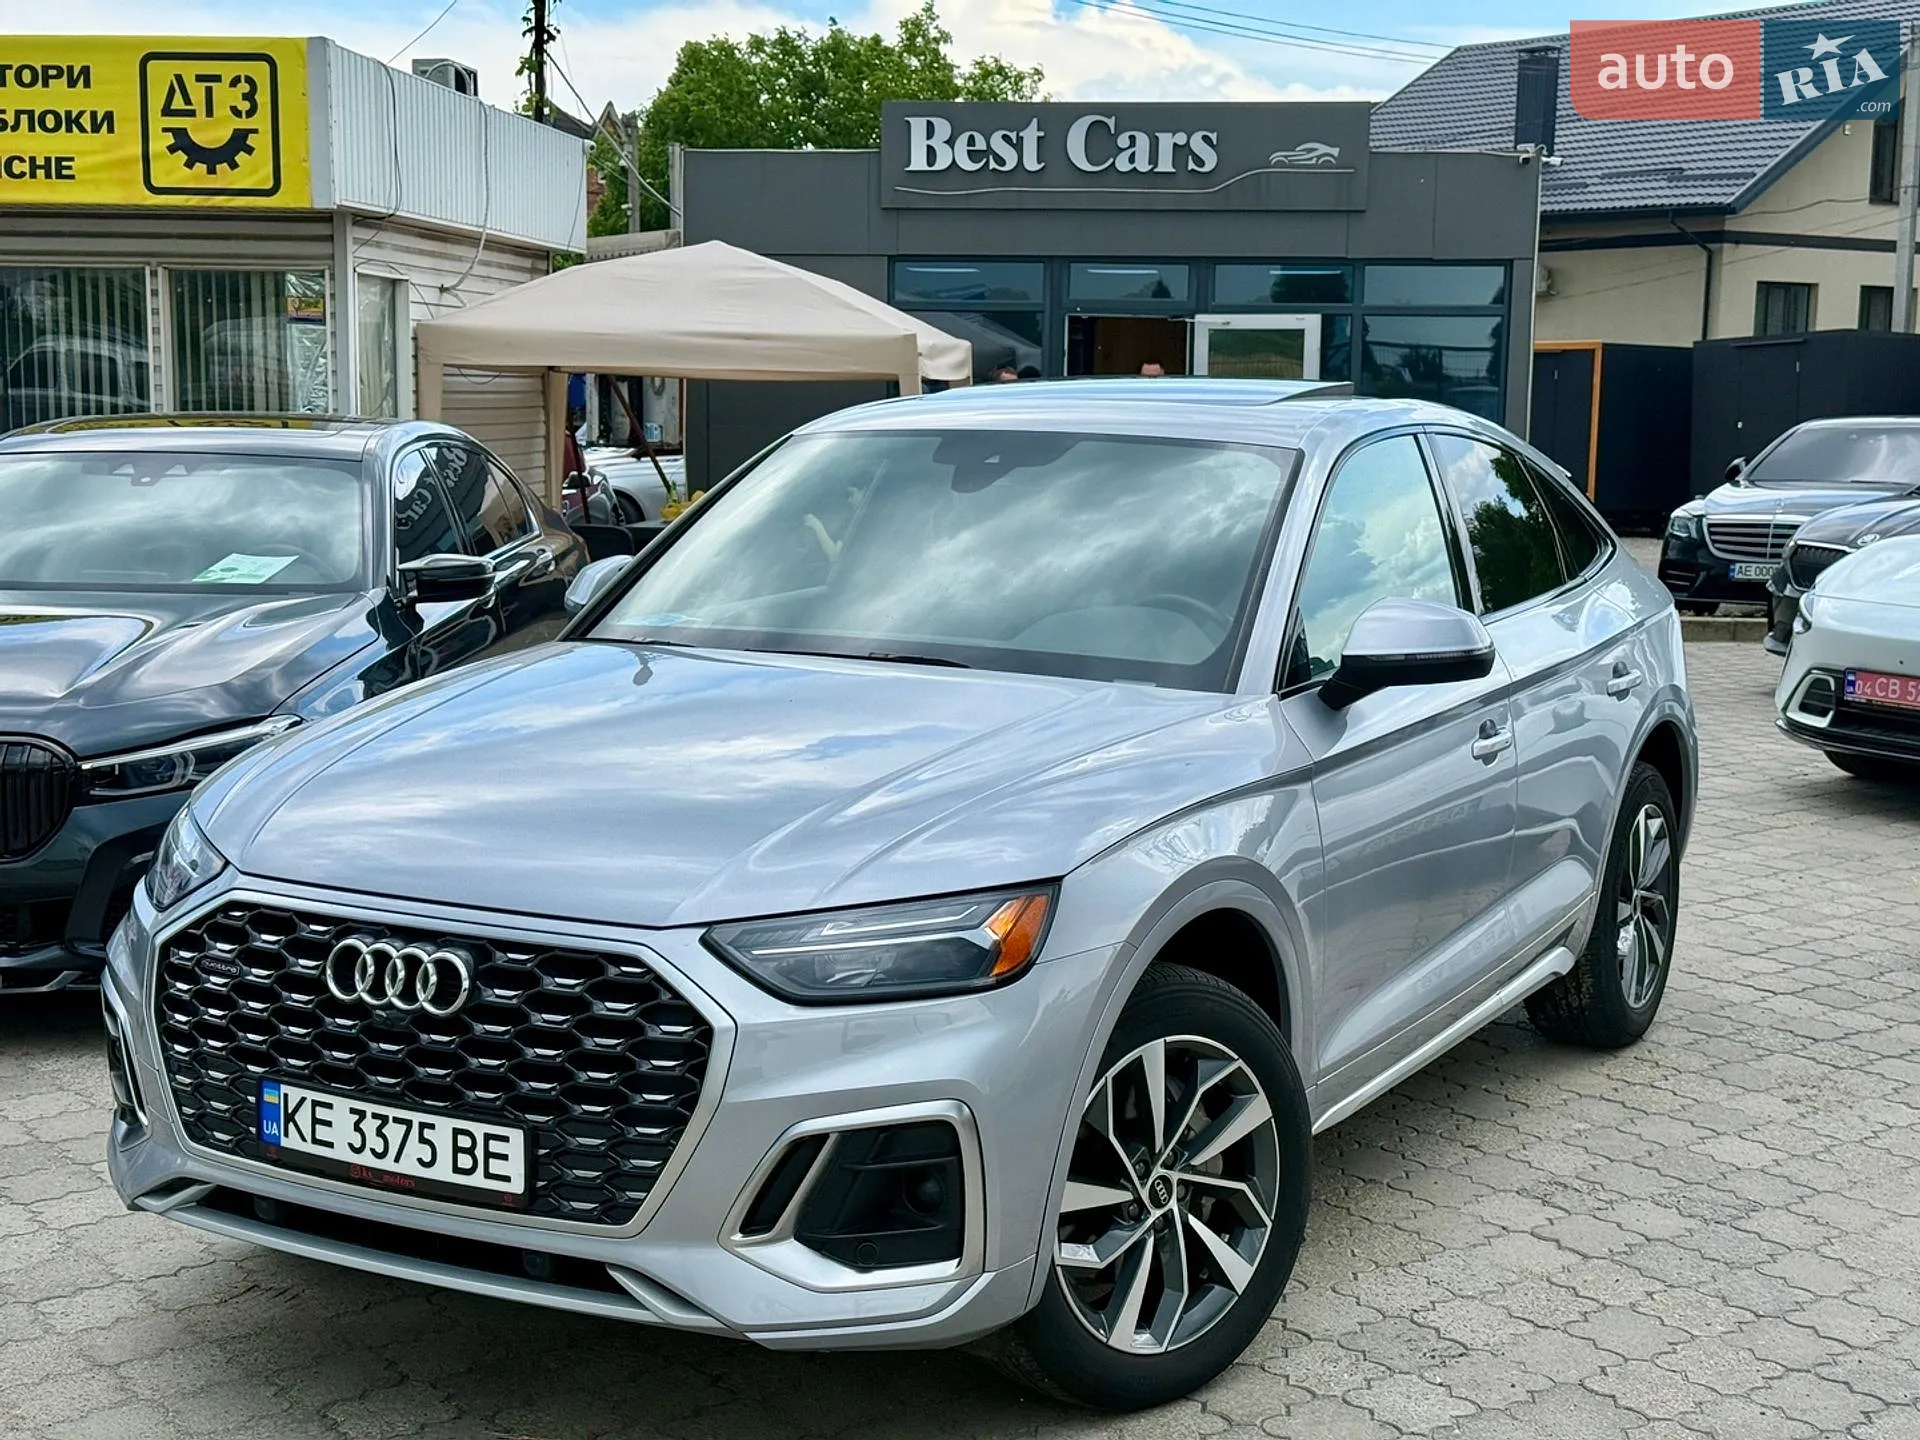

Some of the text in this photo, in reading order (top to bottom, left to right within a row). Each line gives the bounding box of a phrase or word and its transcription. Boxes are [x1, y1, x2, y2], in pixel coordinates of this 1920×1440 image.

[904, 114, 1219, 174] Best Cars
[0, 155, 76, 180] СНЕ
[1736, 565, 1777, 578] AE 000
[262, 1119, 280, 1137] UA
[282, 1092, 512, 1183] KE 3375 BE
